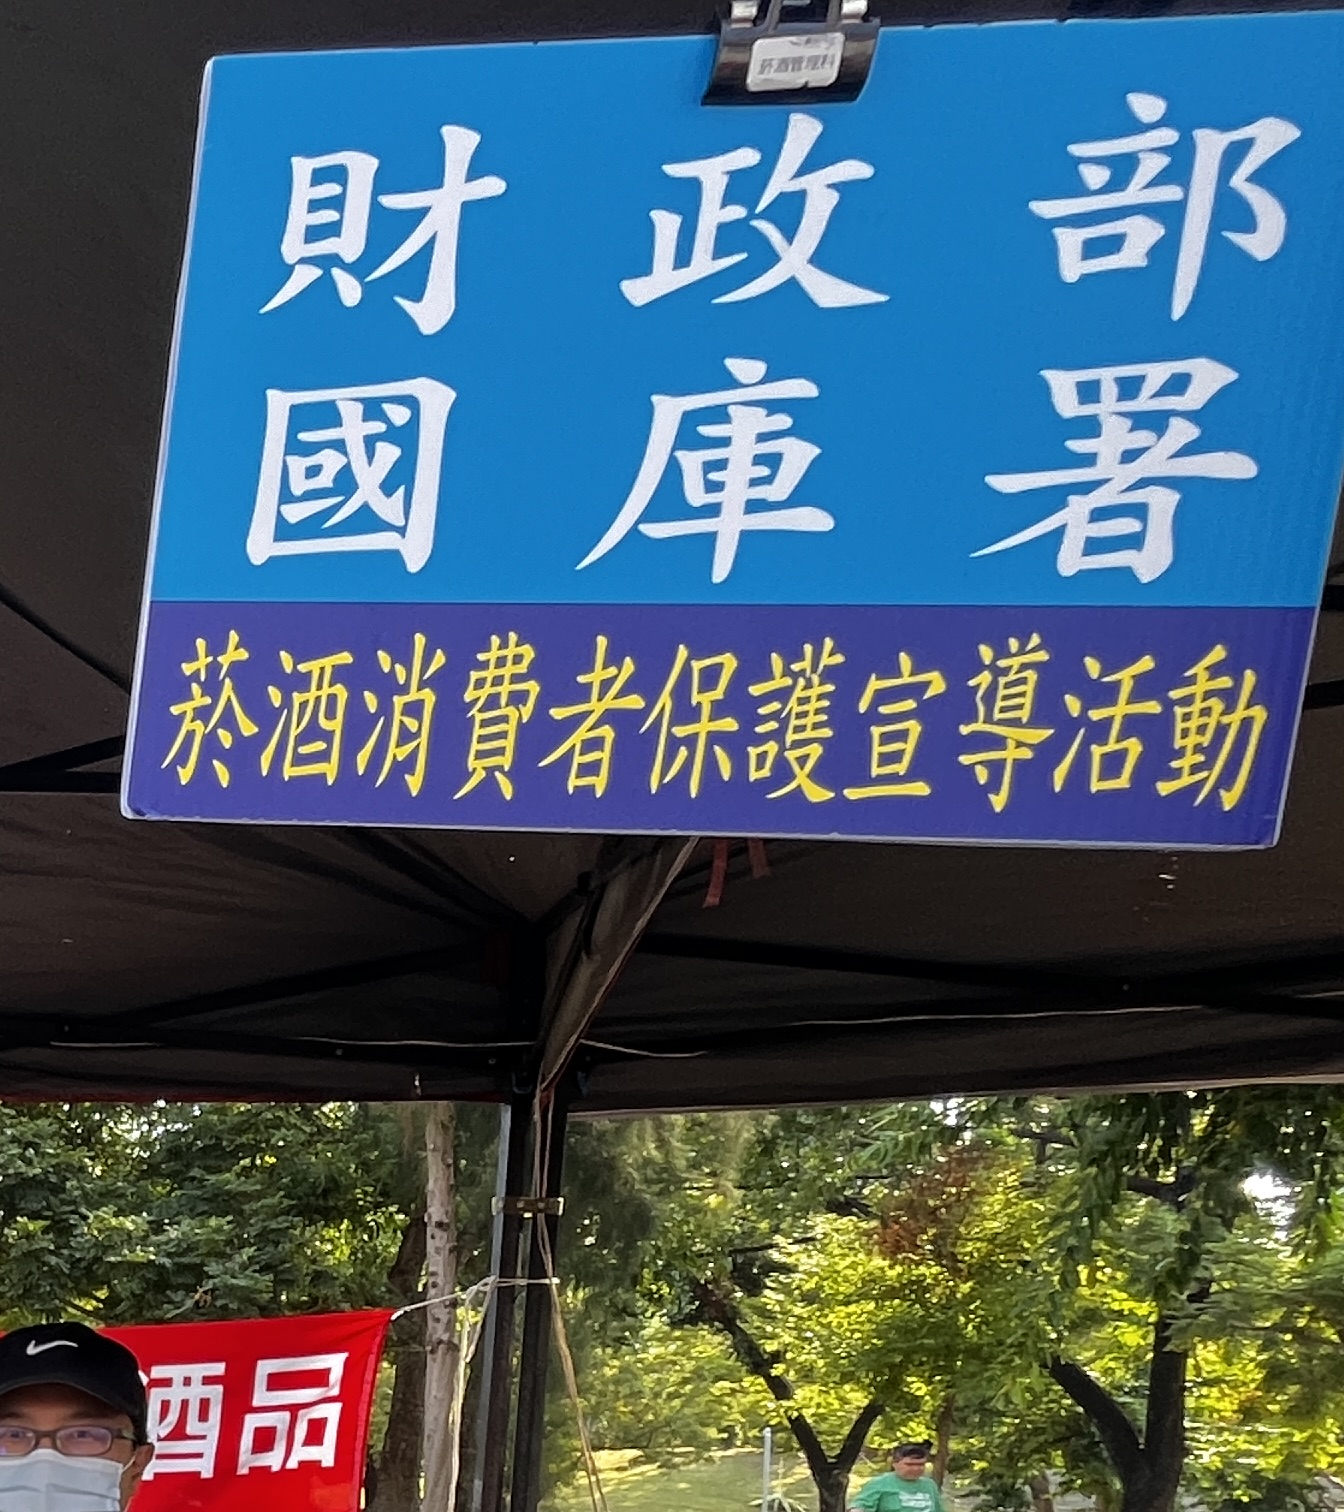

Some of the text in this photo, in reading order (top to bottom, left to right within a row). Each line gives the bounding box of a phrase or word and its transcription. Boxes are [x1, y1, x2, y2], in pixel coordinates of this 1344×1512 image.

[258, 91, 1303, 337] 財政部
[246, 356, 1262, 585] 國庫署
[160, 629, 1269, 814] 菸酒消費者保護宣導活動
